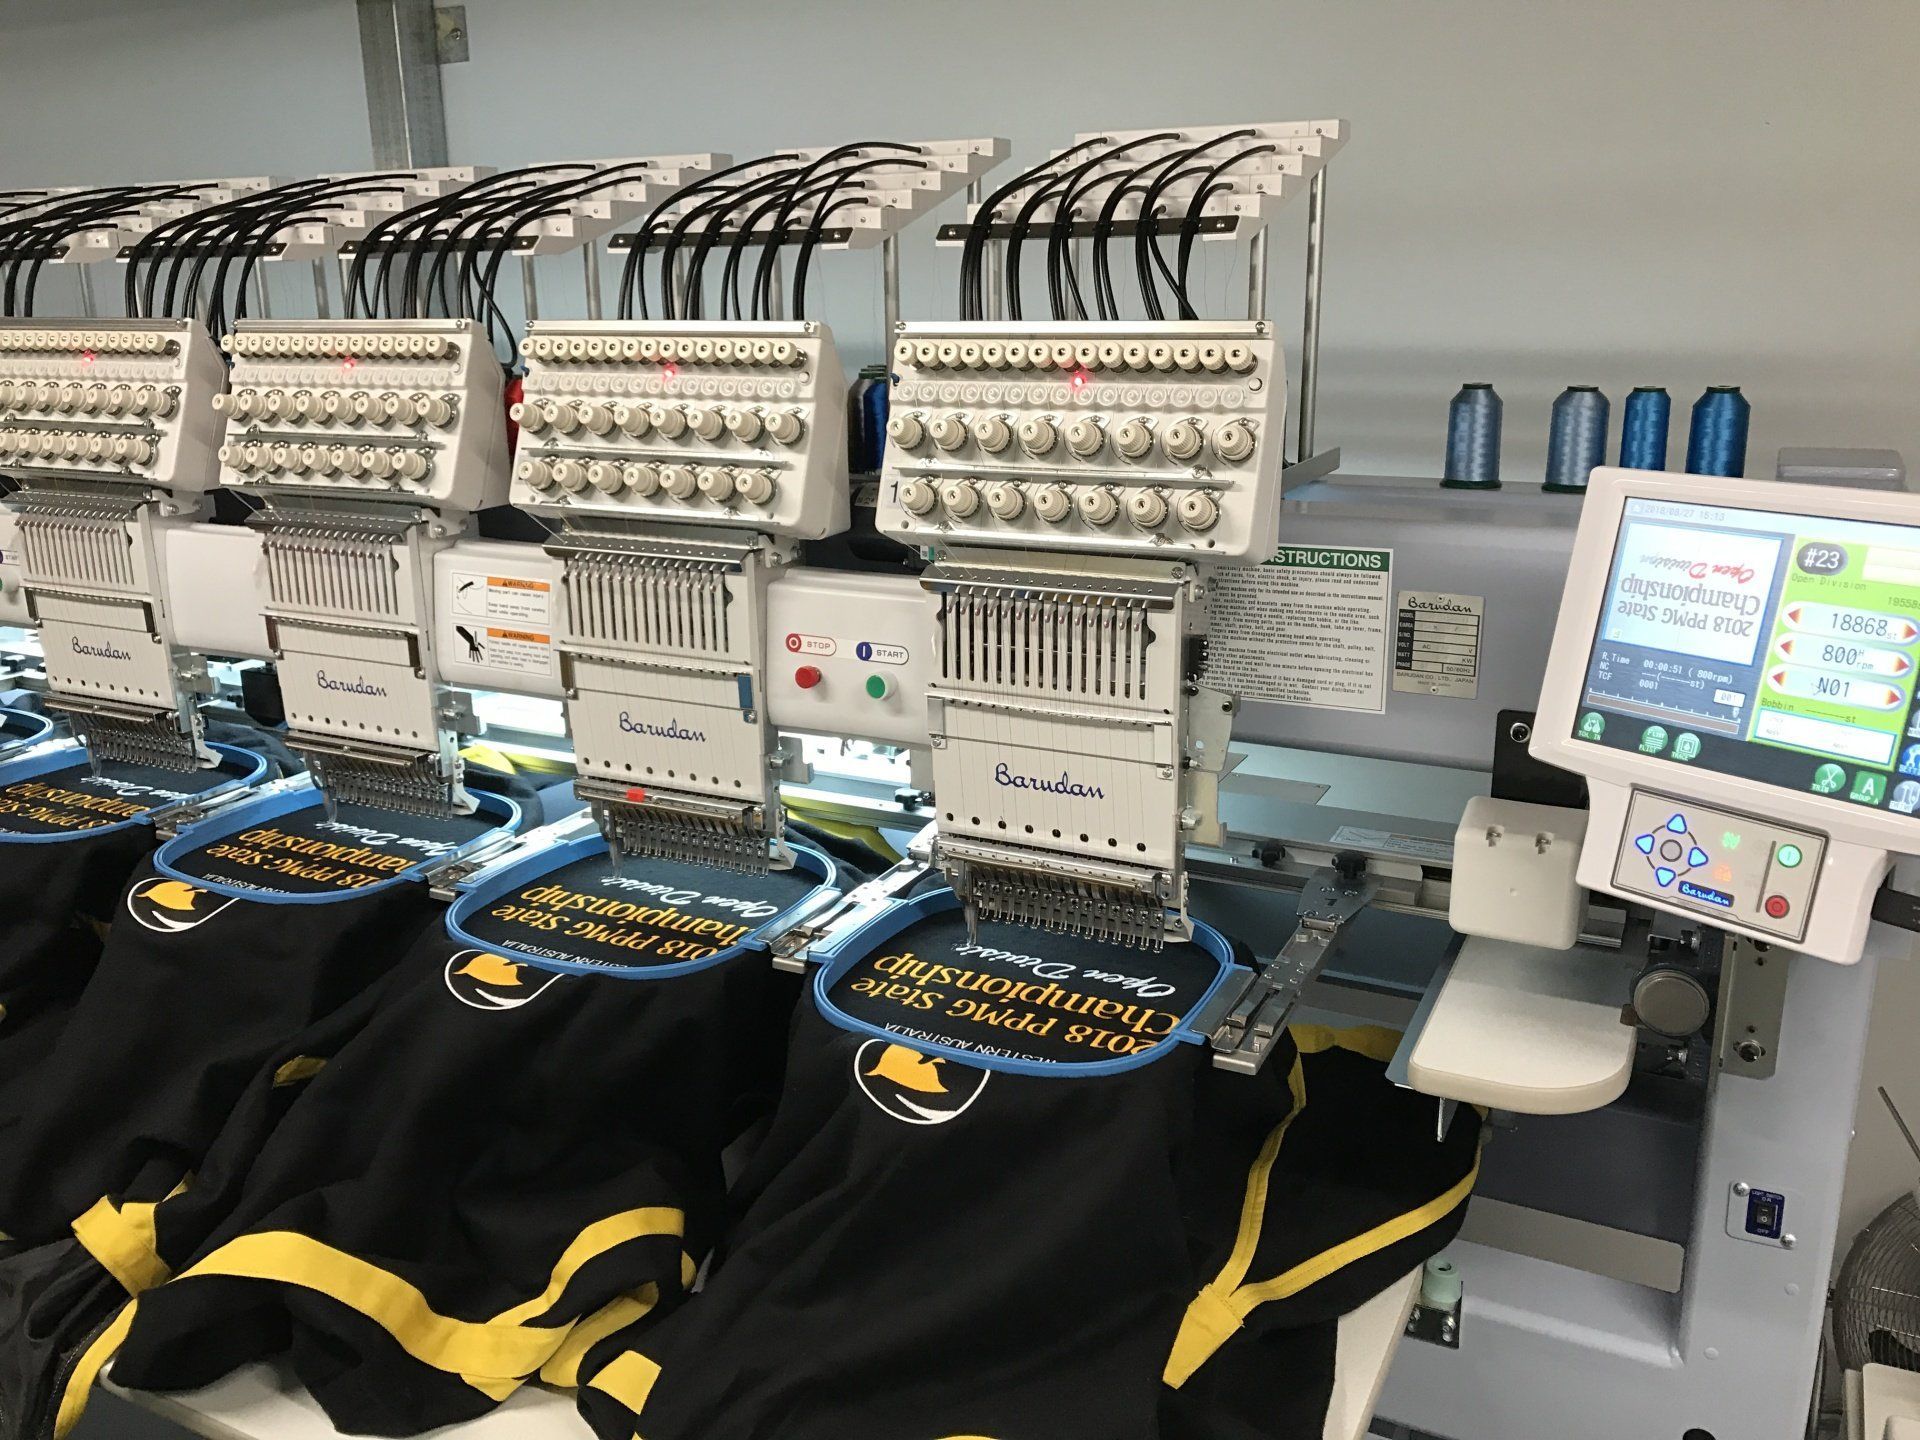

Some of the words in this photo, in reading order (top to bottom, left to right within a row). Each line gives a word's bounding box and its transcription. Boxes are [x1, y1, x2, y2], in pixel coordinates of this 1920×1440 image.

[890, 480, 898, 503] 1
[1270, 549, 1382, 568] STRUCTIONS
[1804, 548, 1840, 568] #23
[1712, 563, 1755, 584] Open
[1792, 574, 1814, 584] Open
[1820, 577, 1866, 590] Division
[1408, 596, 1472, 612] Barudan
[1620, 573, 1761, 616] Championship
[1617, 600, 1658, 622] State
[1661, 607, 1709, 630] PPMG
[1713, 616, 1754, 636] 2018
[72, 636, 132, 661] Barudan
[806, 640, 830, 650] STOP
[876, 649, 904, 658] START
[317, 670, 388, 698] Barudan
[1598, 670, 1612, 680] TCF
[1761, 698, 1794, 711] Bobbin
[618, 712, 707, 744] Barudan
[994, 762, 1105, 800] Barudan
[1862, 778, 1874, 796] A
[206, 844, 274, 865] State
[239, 828, 417, 873] ampionship
[263, 858, 346, 882] PPMG
[336, 874, 381, 888] 18
[1682, 884, 1729, 905] Barudan
[491, 904, 570, 930] State
[520, 884, 756, 946] hampionship
[702, 896, 778, 918] Open
[564, 920, 660, 950] PPMG
[501, 939, 574, 960] AUSTRALIA
[656, 940, 718, 961] 018
[850, 978, 945, 1010] State
[873, 952, 1181, 1035] Championship
[1082, 968, 1176, 998] Open
[945, 998, 1058, 1036] PPMG
[884, 1022, 974, 1050] AUSTRALIA
[1064, 1024, 1159, 1055] 2018
